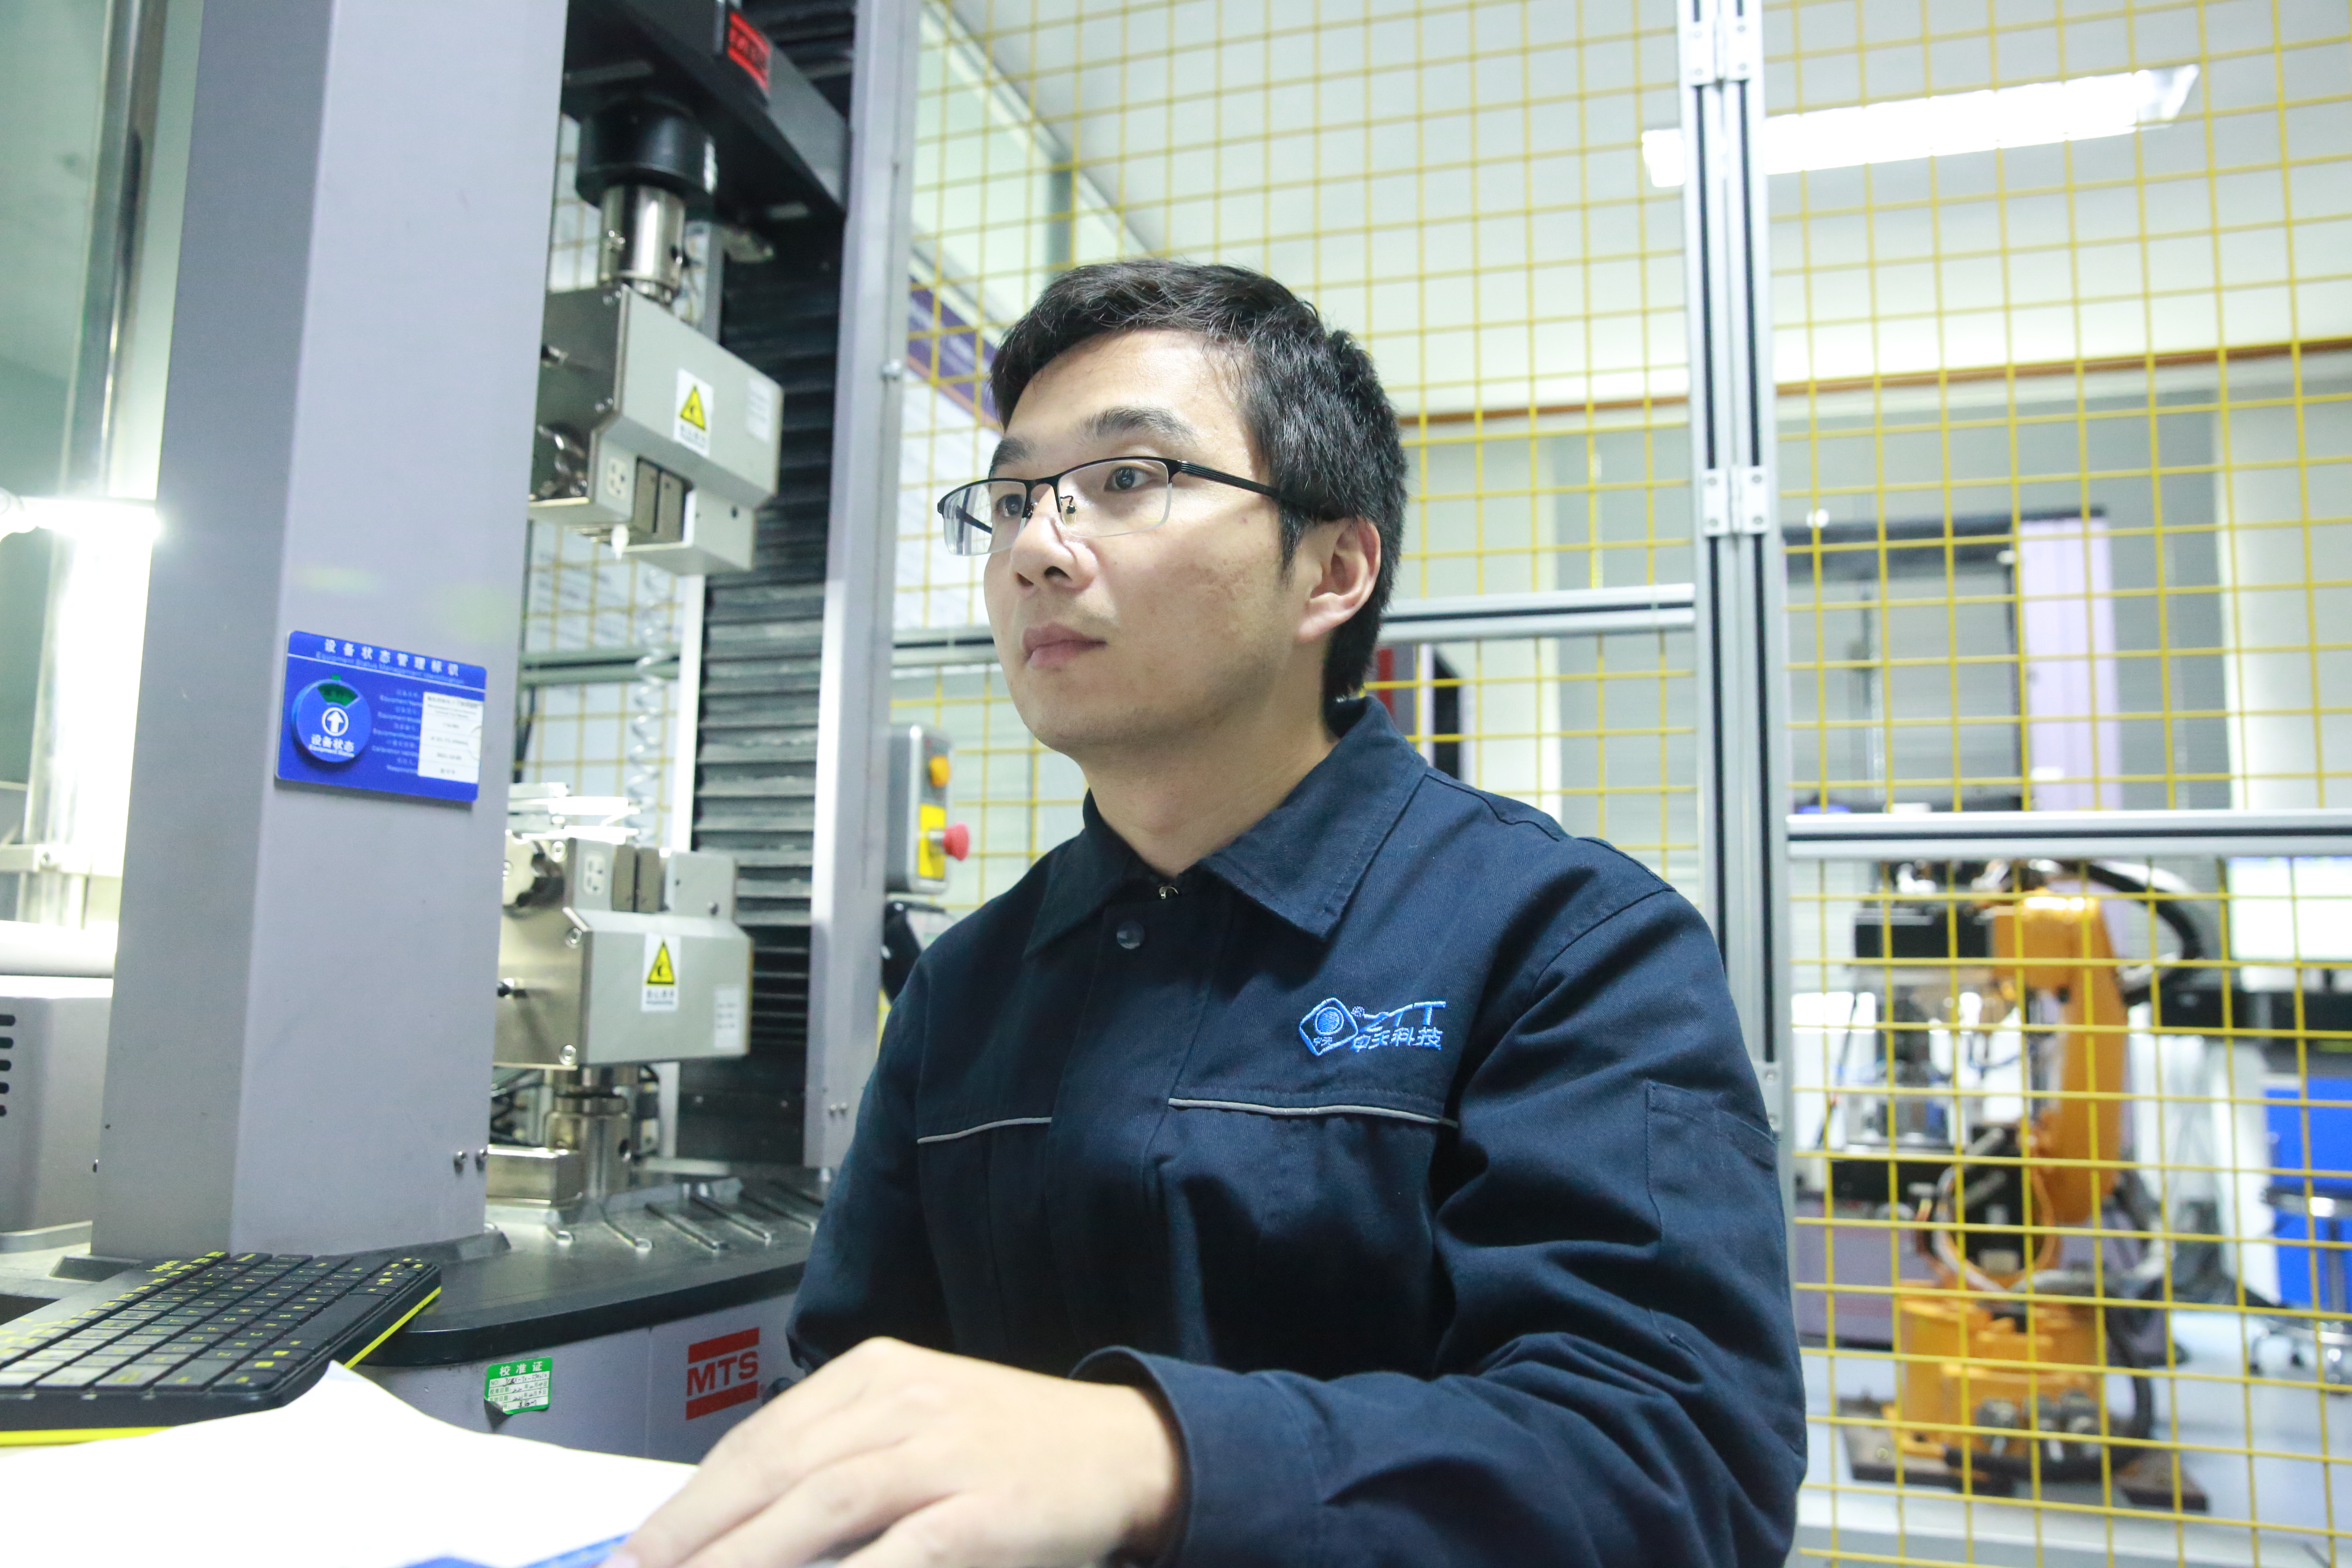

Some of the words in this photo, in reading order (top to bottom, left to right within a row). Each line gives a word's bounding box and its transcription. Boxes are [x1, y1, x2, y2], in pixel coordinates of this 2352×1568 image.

[311, 734, 354, 752] 设备状态
[499, 1361, 543, 1377] 校准证
[687, 1351, 759, 1396] MTS
